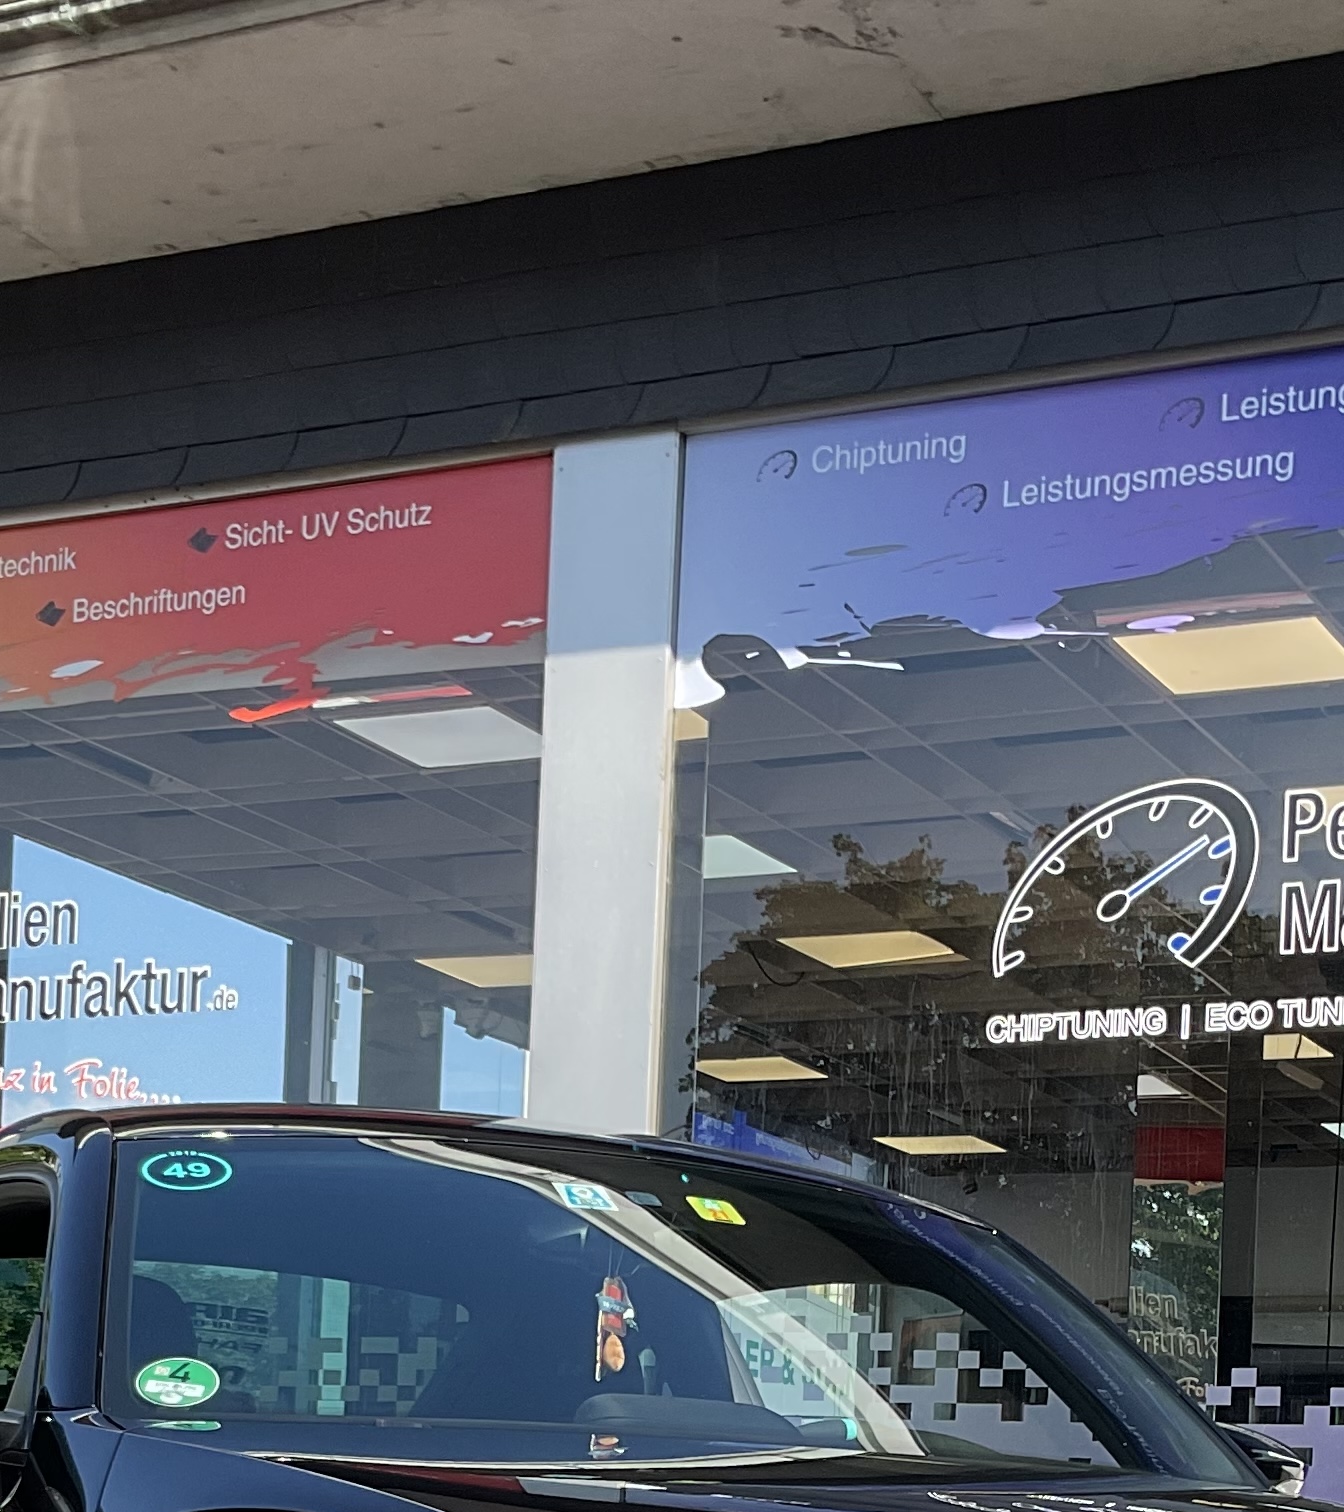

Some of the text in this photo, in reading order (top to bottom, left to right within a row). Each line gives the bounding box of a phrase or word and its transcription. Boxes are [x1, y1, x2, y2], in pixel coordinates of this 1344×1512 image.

[810, 433, 966, 475] Chiptuning
[1001, 450, 1295, 508] Leistungsmessung
[301, 511, 340, 540] UV
[345, 502, 431, 536] Schutz
[72, 584, 246, 624] Beschriftungen
[985, 1006, 1166, 1045] CHIPTUNING
[1203, 1002, 1272, 1034] ECO
[31, 1060, 58, 1093] in
[163, 1162, 211, 1178] 49
[169, 1361, 191, 1382] 4
